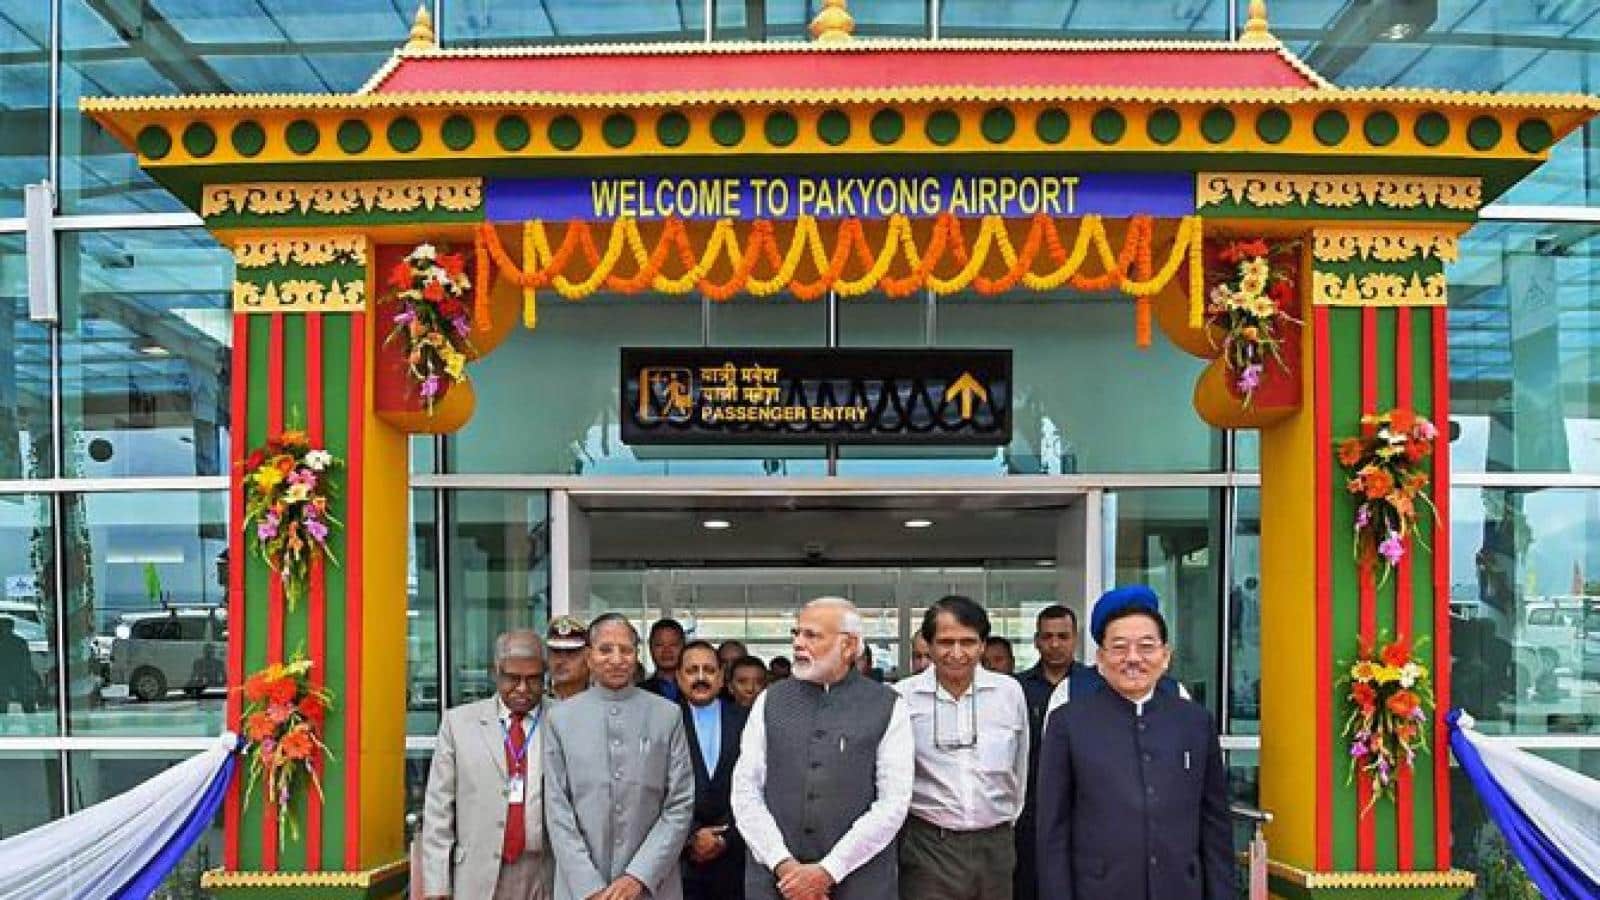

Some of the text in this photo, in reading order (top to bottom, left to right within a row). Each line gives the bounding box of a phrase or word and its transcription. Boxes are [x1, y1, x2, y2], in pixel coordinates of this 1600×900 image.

[591, 176, 1079, 217] WELCOME TO PAKYONG AIRPORT
[701, 406, 868, 421] PASSENGER ENTRY
